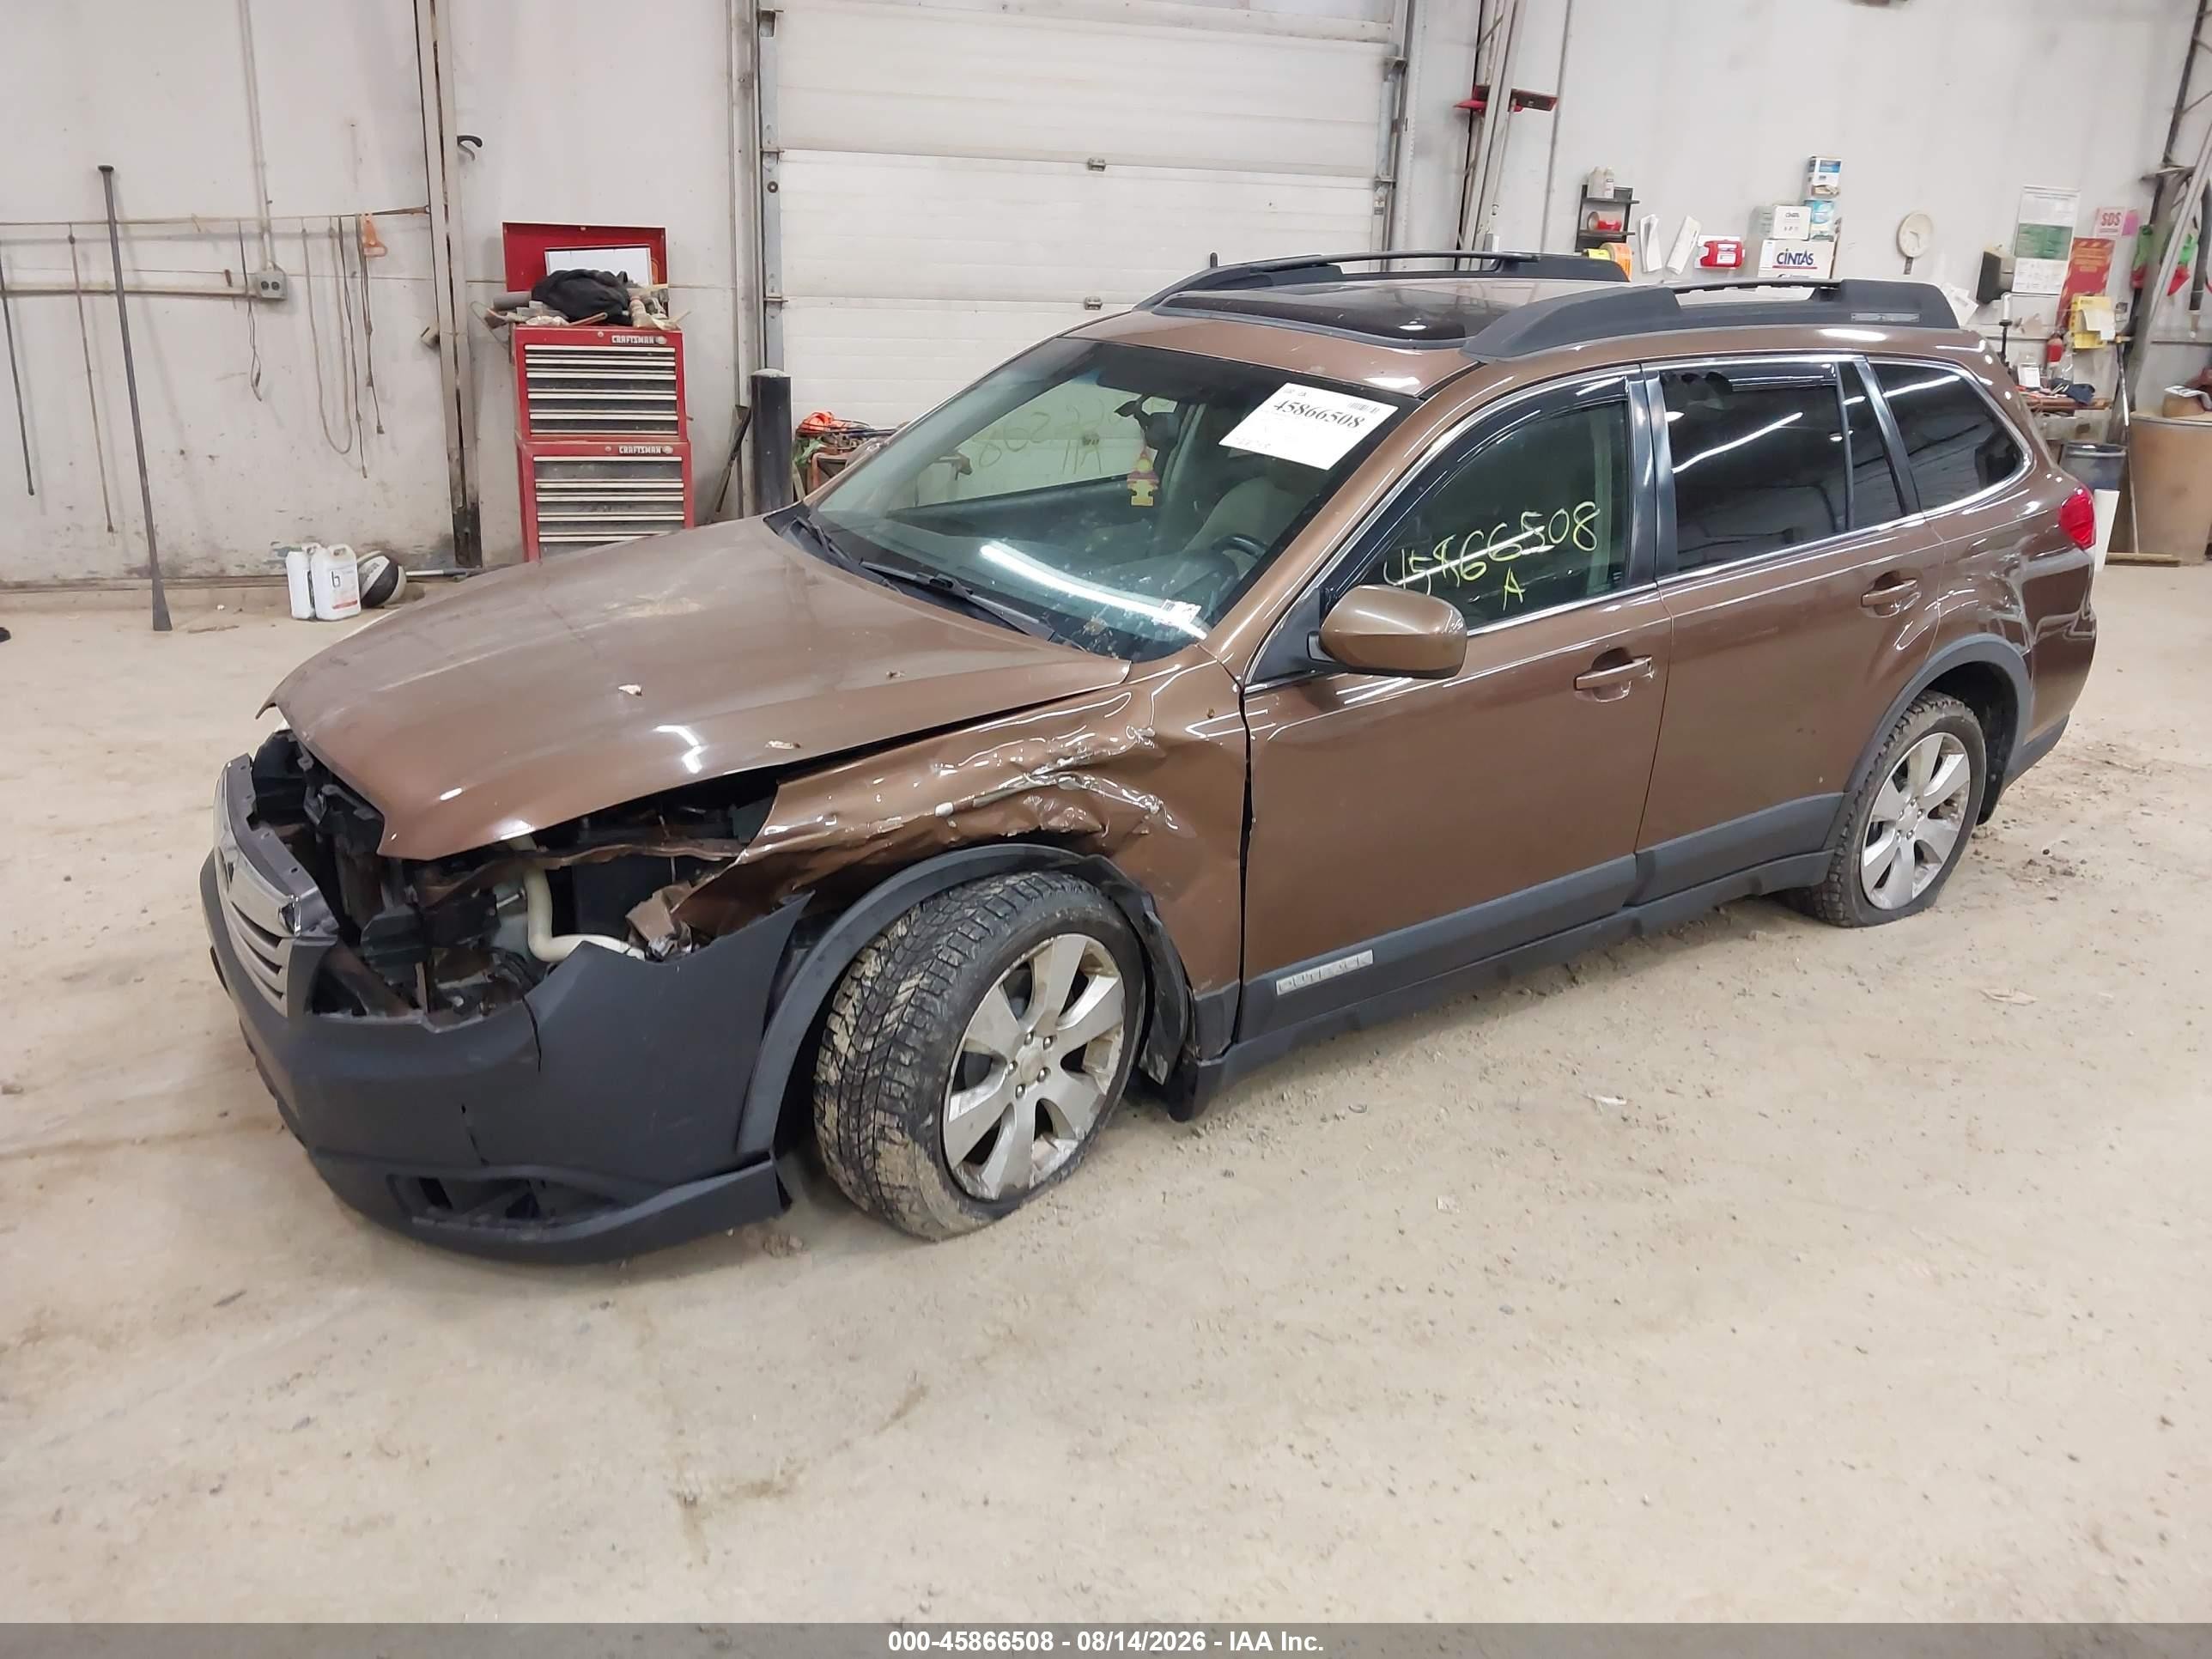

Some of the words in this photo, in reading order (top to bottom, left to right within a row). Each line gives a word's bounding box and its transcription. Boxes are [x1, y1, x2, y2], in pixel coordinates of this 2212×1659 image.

[2100, 211, 2122, 227] SDS
[1777, 248, 1814, 265] CINTAS
[611, 335, 654, 344] CRAFTSMAN
[1273, 400, 1365, 428] 45866508
[618, 446, 661, 455] CRAFTSMAN
[1503, 565, 1527, 611] A
